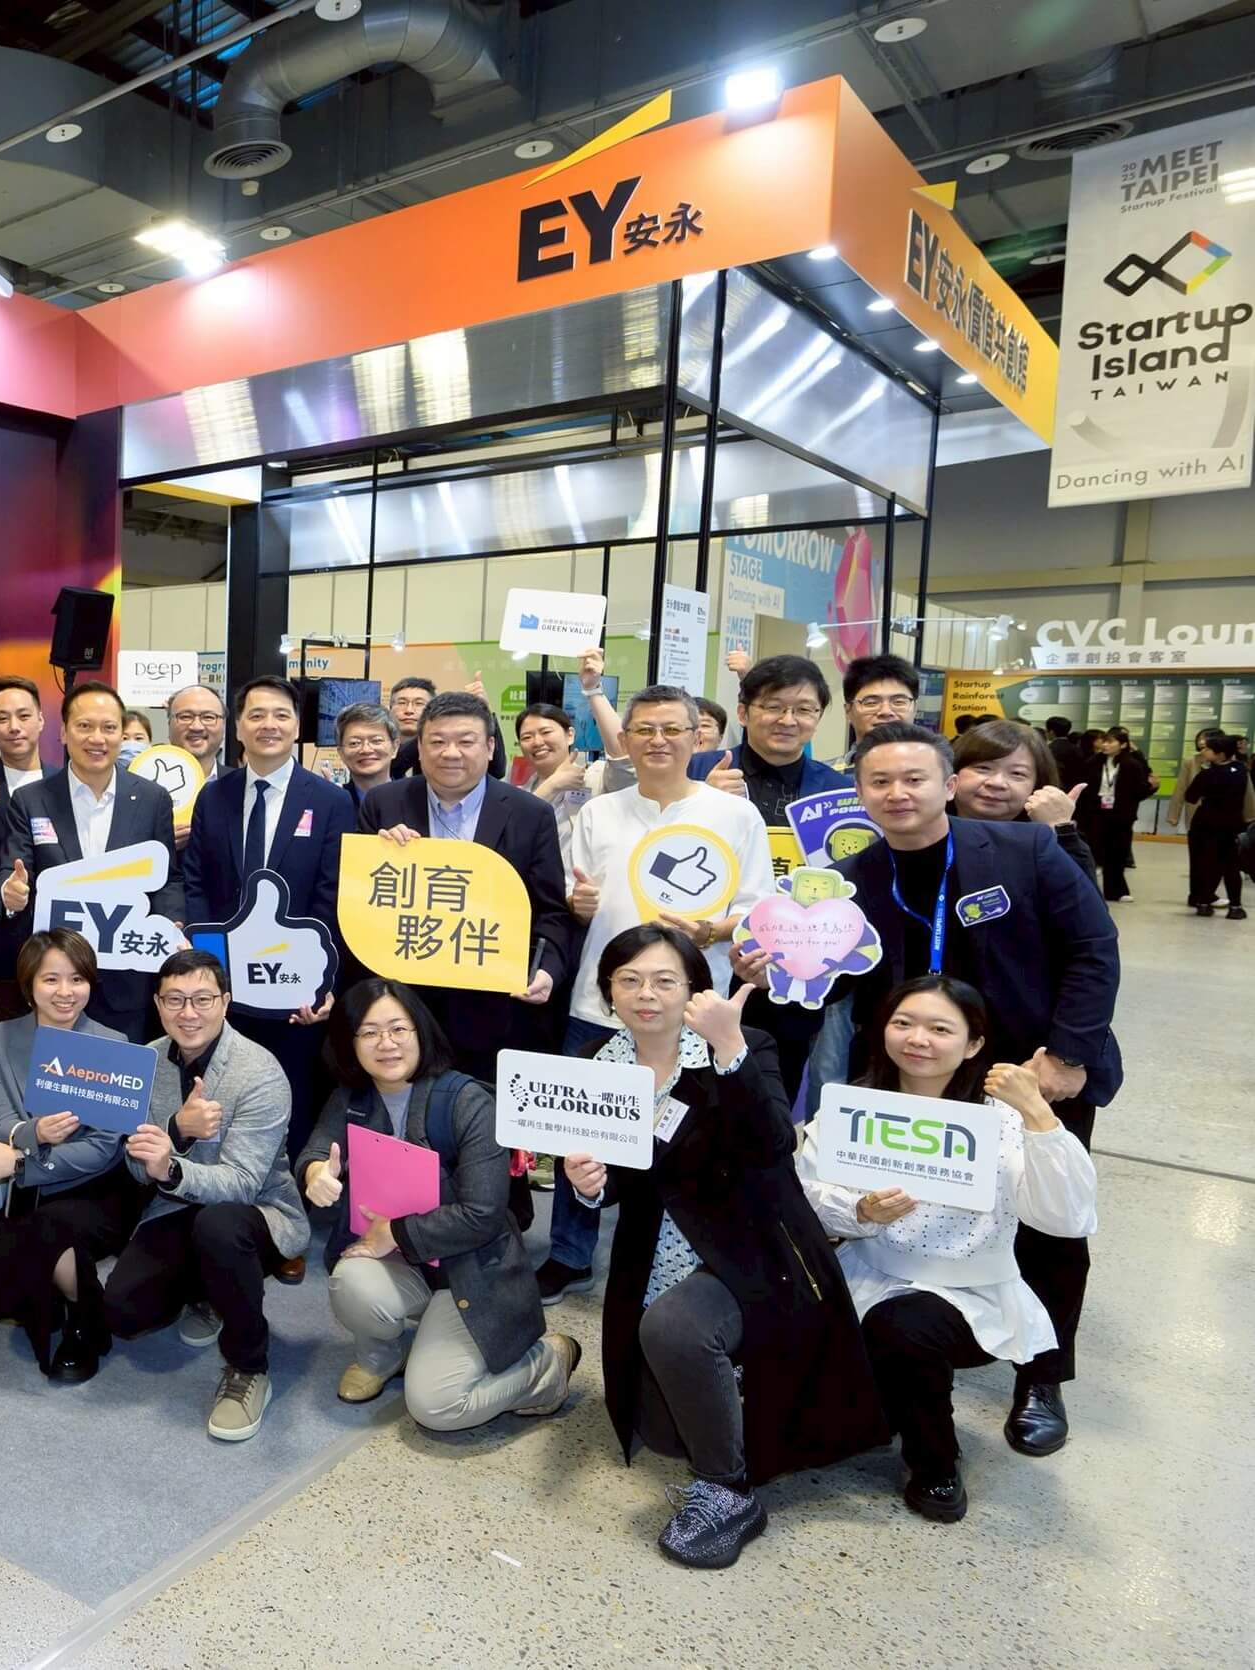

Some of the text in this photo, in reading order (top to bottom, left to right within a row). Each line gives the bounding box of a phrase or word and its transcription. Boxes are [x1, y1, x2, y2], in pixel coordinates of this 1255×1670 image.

[1139, 140, 1223, 178] MEET
[1120, 162, 1219, 202] TAIPEI
[1120, 183, 1218, 214] Startup Festival
[518, 175, 643, 283] EY
[623, 201, 705, 256] 安永
[905, 208, 939, 303] EY
[934, 248, 1029, 396] 安永價值共創館
[1077, 302, 1254, 350] Startup
[1092, 324, 1231, 381] Island
[1091, 371, 1229, 400] TAIWAN
[1056, 454, 1245, 490] Dancing with AI
[730, 554, 762, 581] STAGE
[734, 531, 835, 574] OMORROW
[541, 624, 594, 635] GREEN VALUE
[1036, 618, 1127, 647] CVC
[288, 657, 329, 670] mnity
[1045, 650, 1187, 665] 企業創投會客室
[952, 692, 1004, 700] Rainforest
[954, 681, 991, 689] Startup
[368, 861, 473, 912] 創育
[49, 899, 170, 956] EY 安永
[394, 914, 500, 966] 夥伴
[247, 963, 301, 984] EY 安永
[66, 1064, 144, 1090] AeproMED
[529, 1081, 588, 1100] ULTRA
[534, 1096, 641, 1121] GLORIOUS
